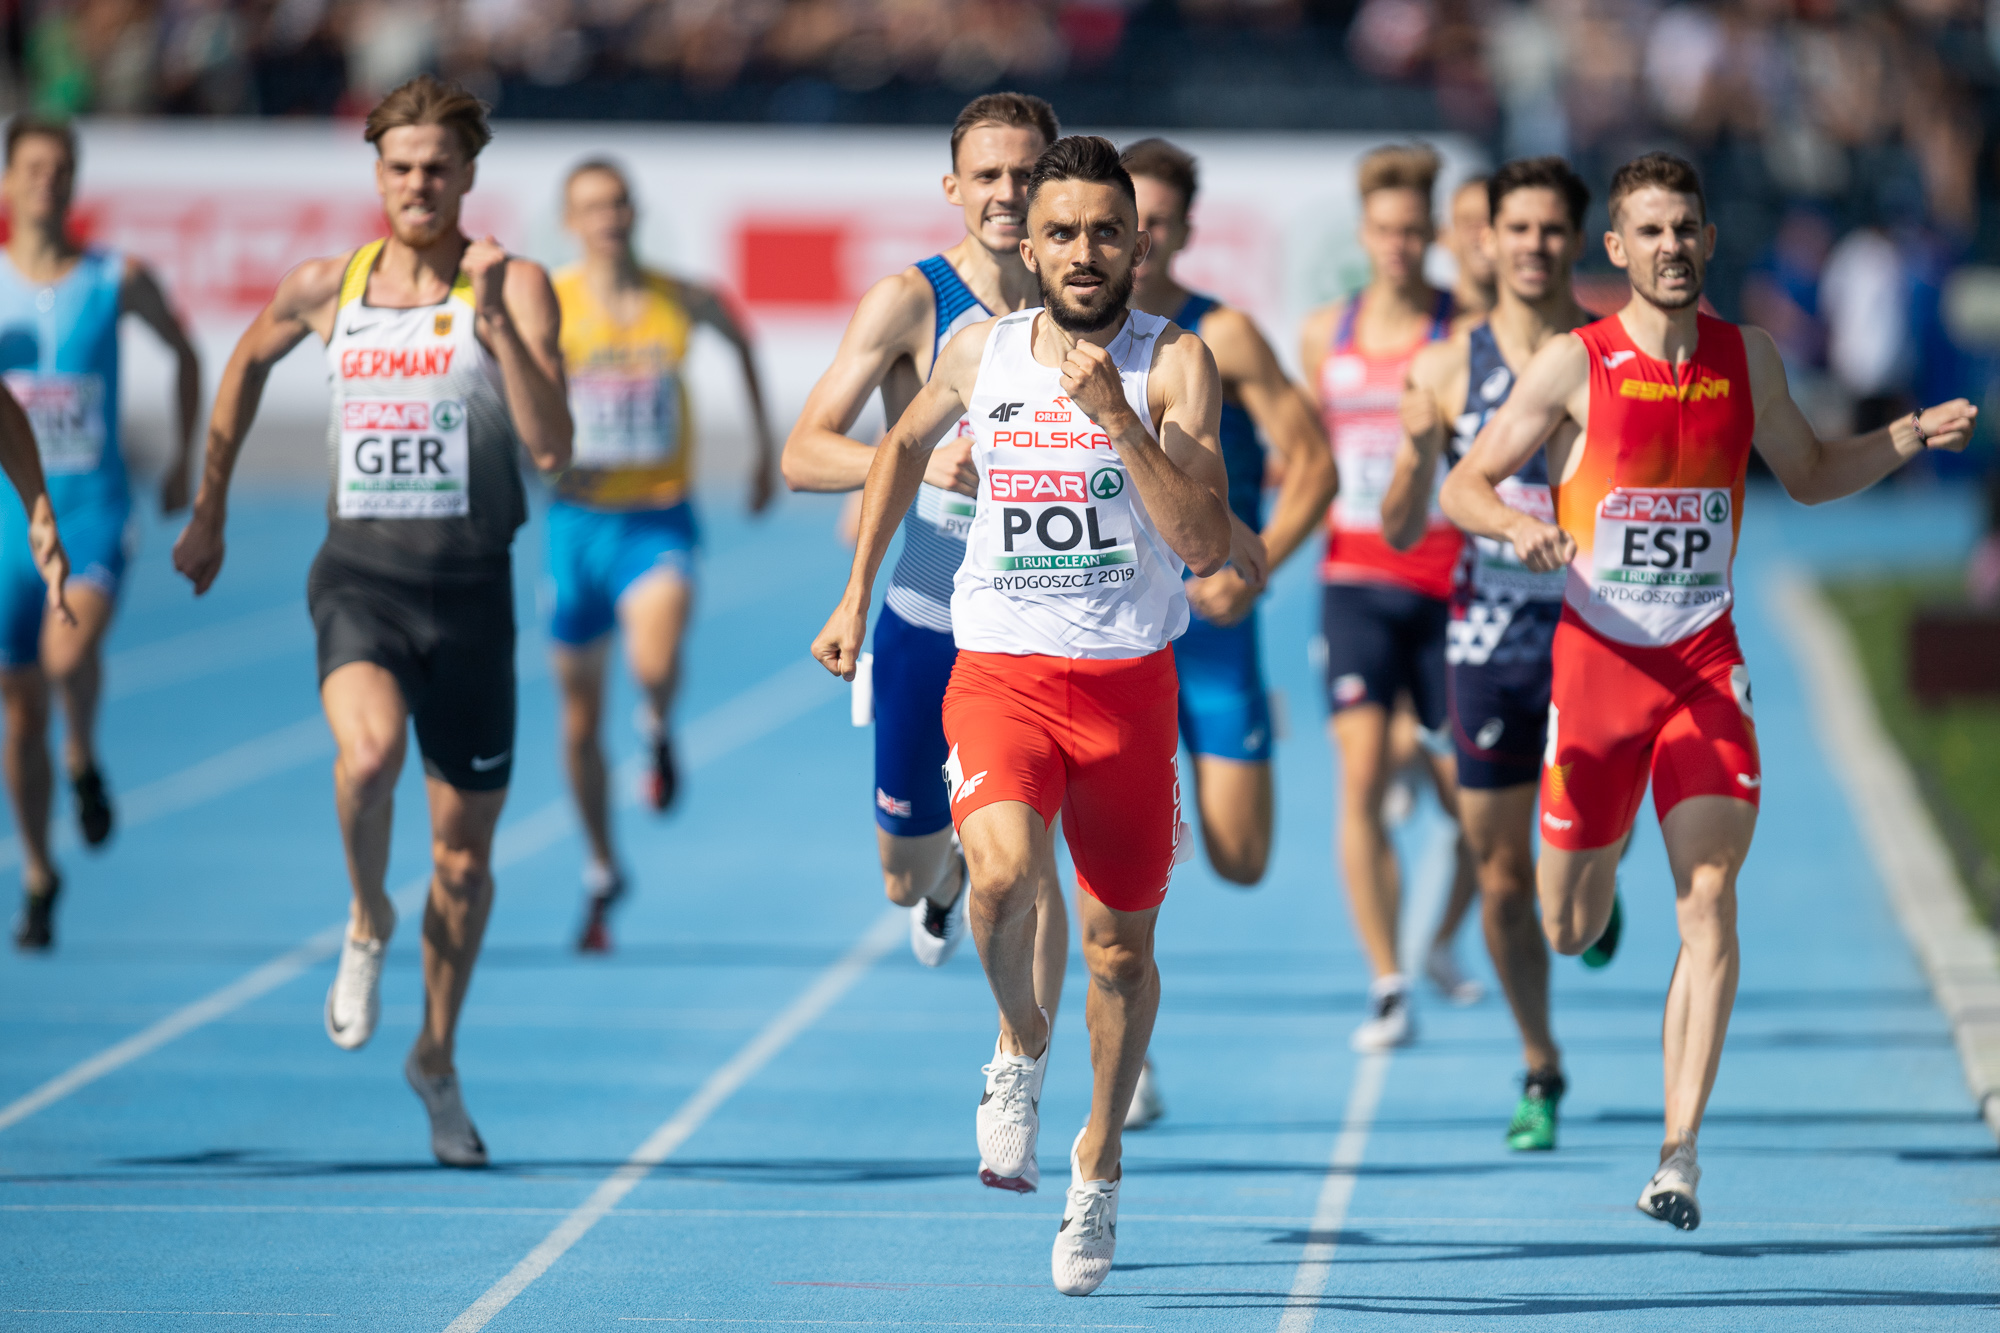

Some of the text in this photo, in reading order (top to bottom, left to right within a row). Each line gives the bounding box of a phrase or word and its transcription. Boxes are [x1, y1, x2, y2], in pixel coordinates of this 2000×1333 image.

[341, 346, 456, 378] GERMANY
[1619, 376, 1731, 402] ESPAÑA
[345, 403, 427, 429] SPAR
[988, 402, 1025, 422] 4F
[1036, 412, 1070, 422] ORLEN
[993, 431, 1113, 450] POLSKA
[354, 437, 450, 474] GER
[991, 473, 1085, 499] SPAR
[1604, 492, 1699, 520] SPAR
[1003, 506, 1118, 552] POL
[1622, 525, 1711, 569] ESP
[1015, 557, 1019, 568] I
[1023, 556, 1052, 568] RUN
[993, 568, 1135, 590] BYDGOSZCZ 2019
[1629, 571, 1657, 583] RUN
[1599, 585, 1691, 606] BYDGOSZCZ
